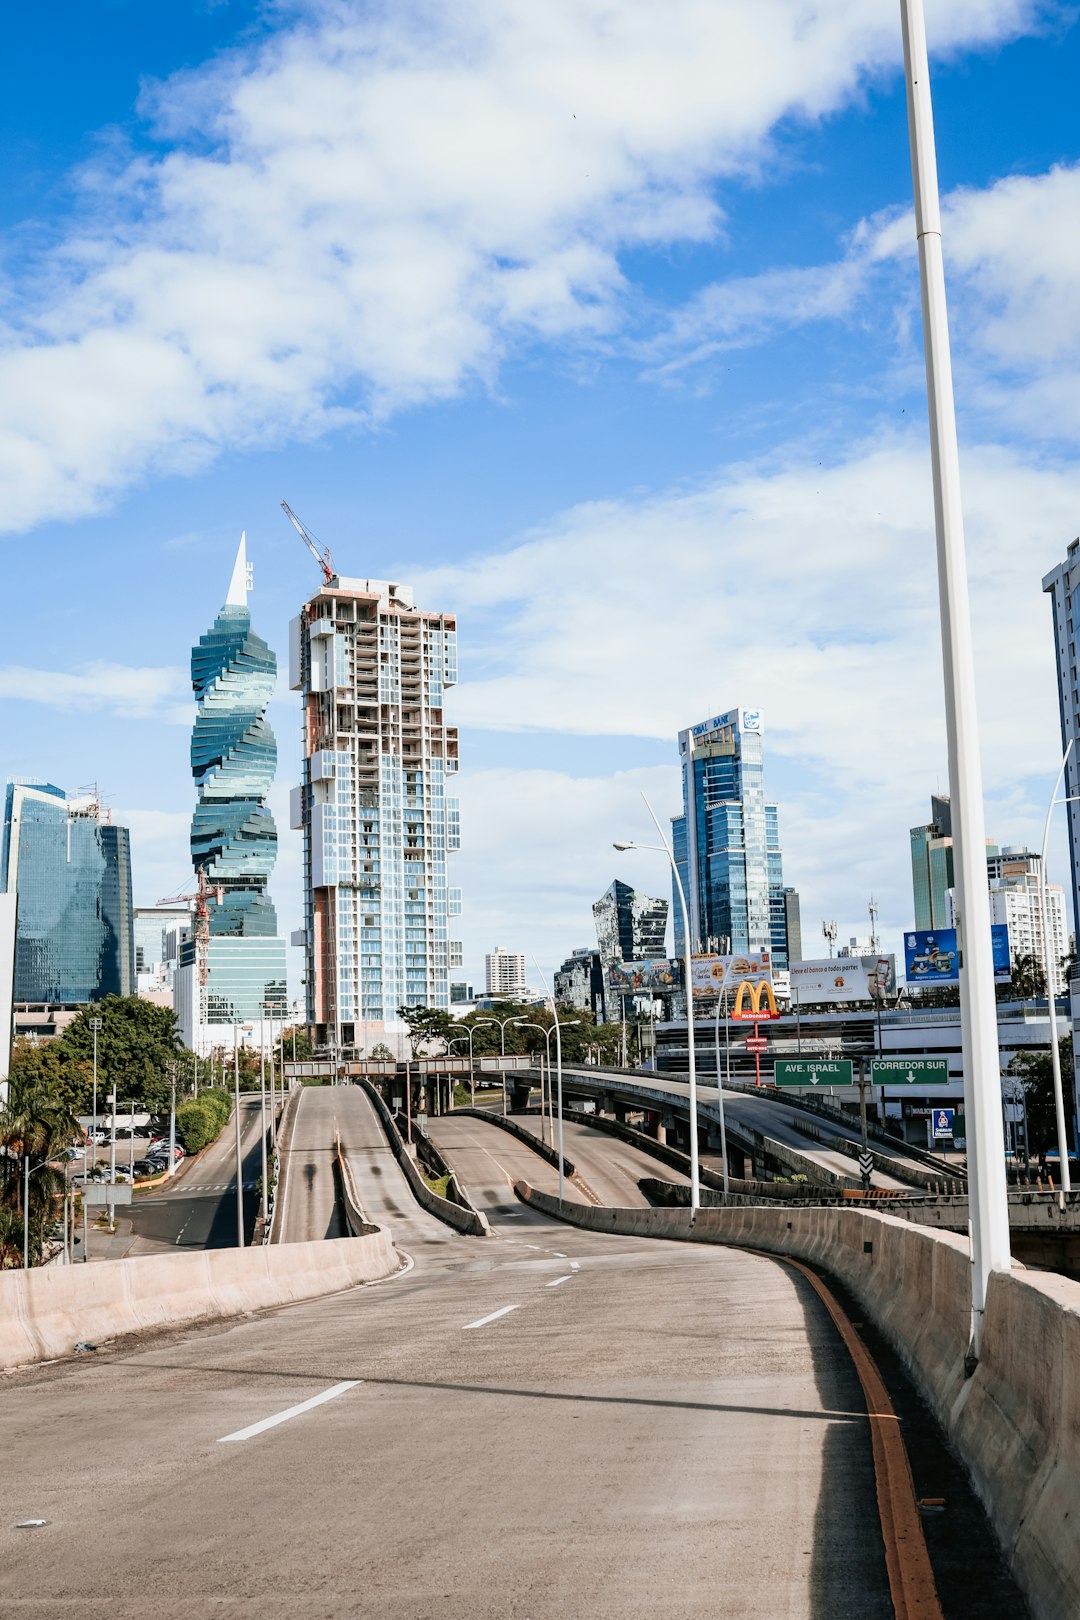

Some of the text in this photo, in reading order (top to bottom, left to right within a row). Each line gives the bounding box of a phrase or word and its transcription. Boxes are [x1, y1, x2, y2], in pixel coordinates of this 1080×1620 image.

[691, 714, 729, 735] OBAL BANK
[807, 1064, 840, 1072] ISRAEL
[873, 1061, 946, 1070] CORREDOR SUR
